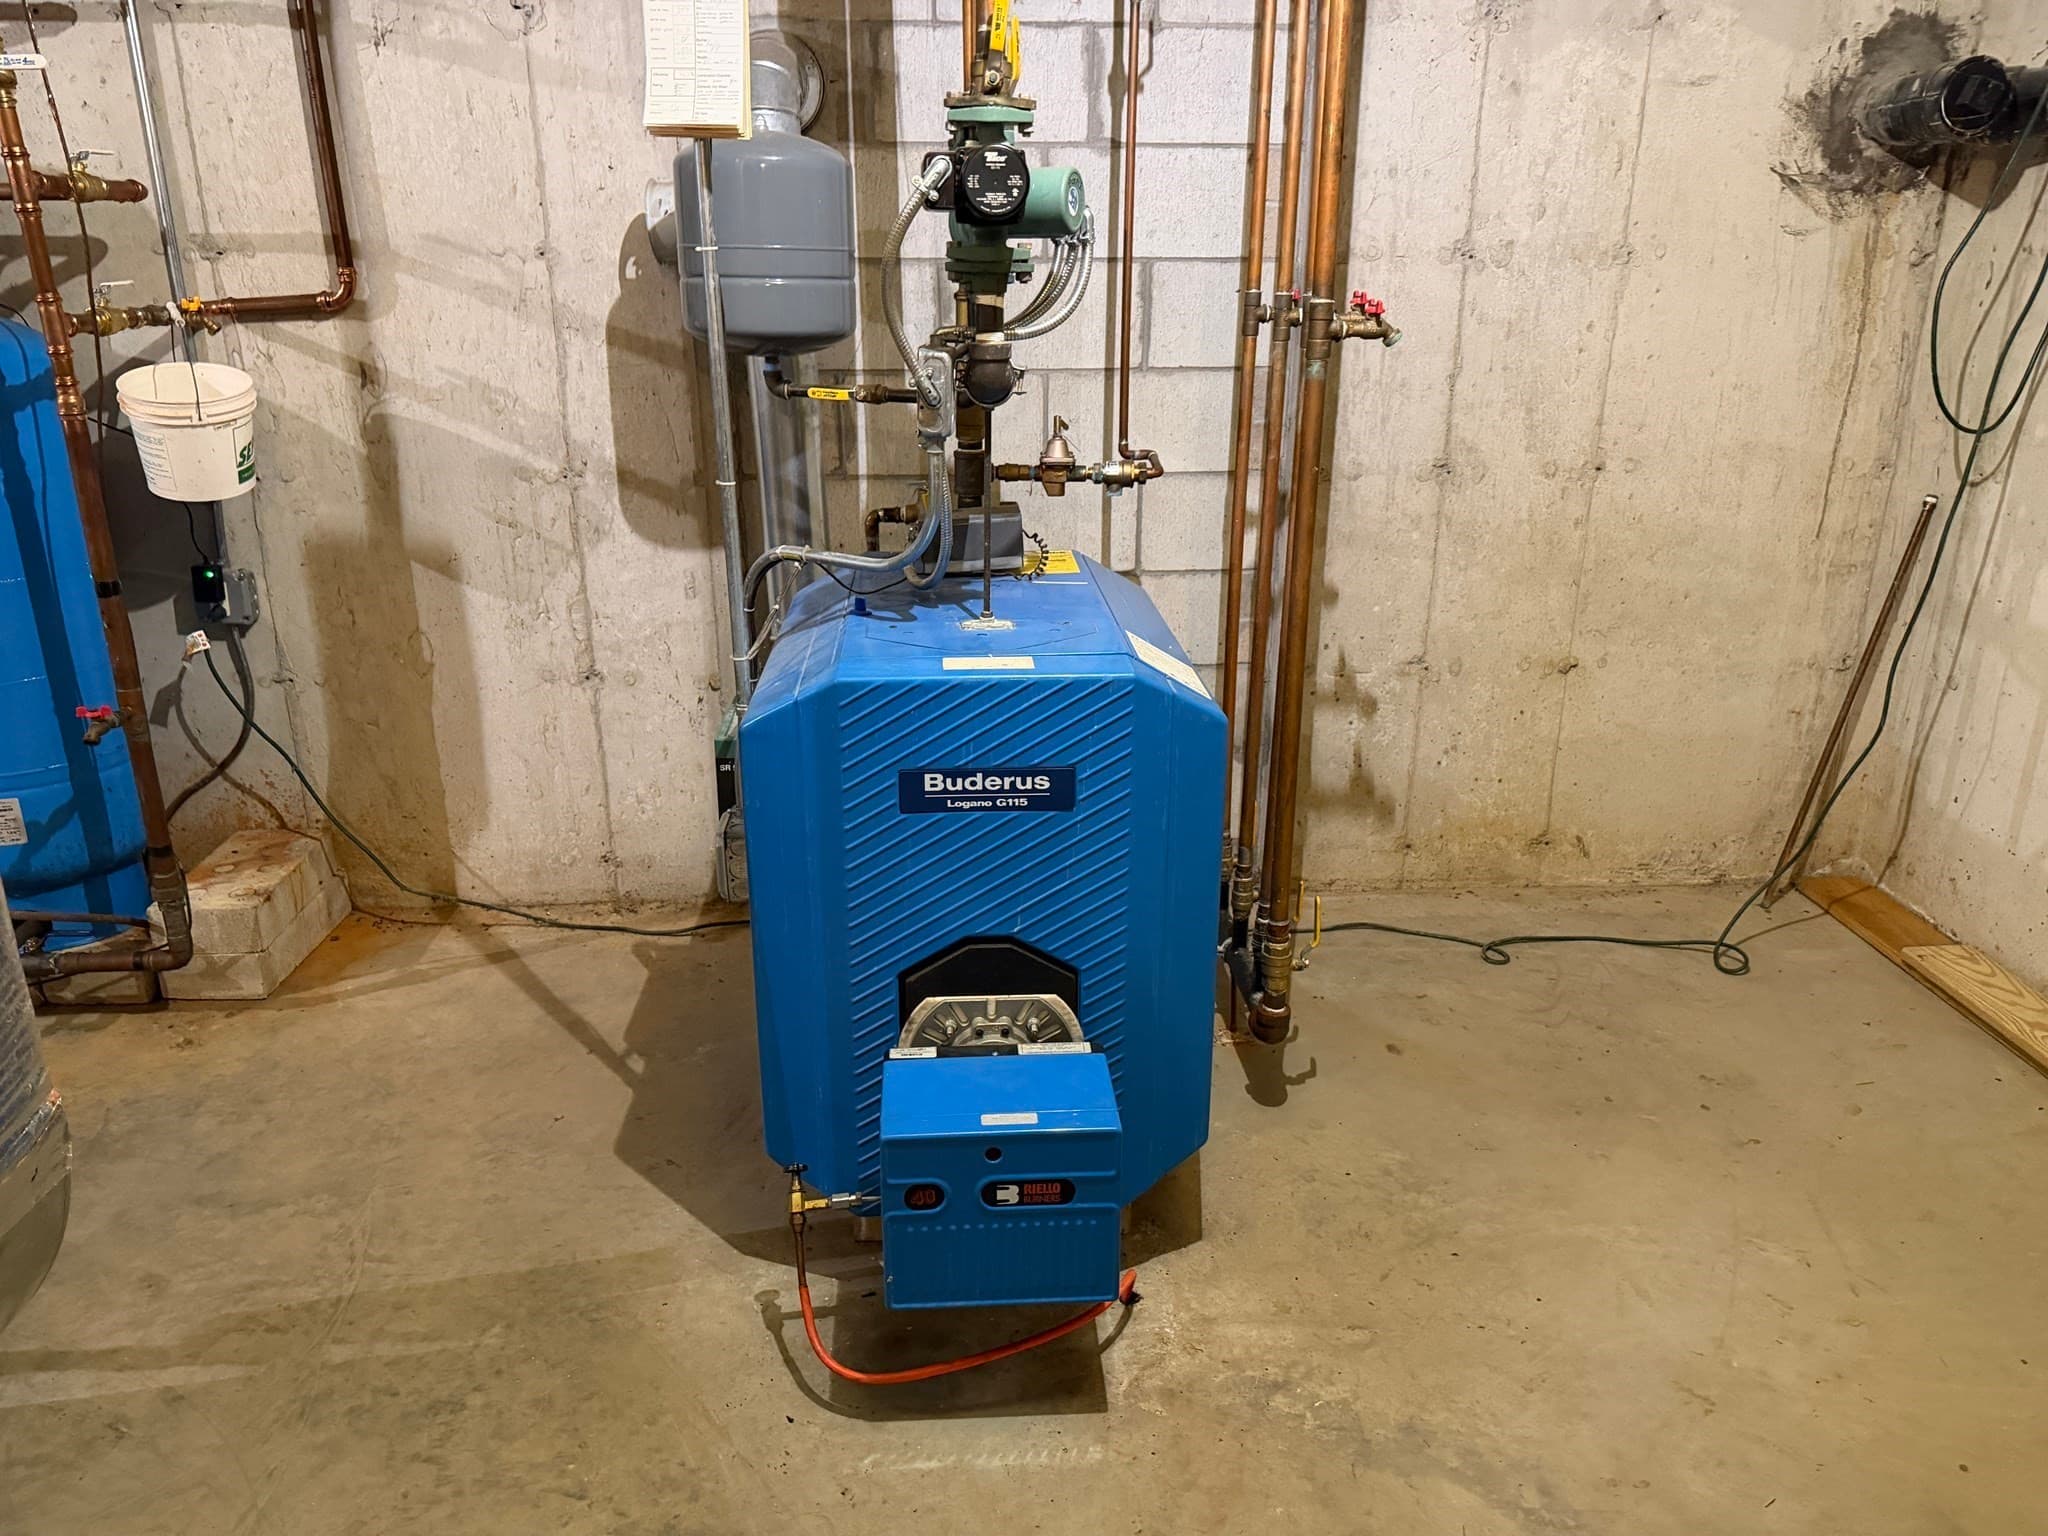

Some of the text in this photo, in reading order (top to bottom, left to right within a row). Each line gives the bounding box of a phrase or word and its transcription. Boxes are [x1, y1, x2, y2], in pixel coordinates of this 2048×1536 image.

[923, 772, 1051, 792] Buderus
[947, 798, 1028, 809] Logano G115
[1023, 1183, 1061, 1195] RIELLO
